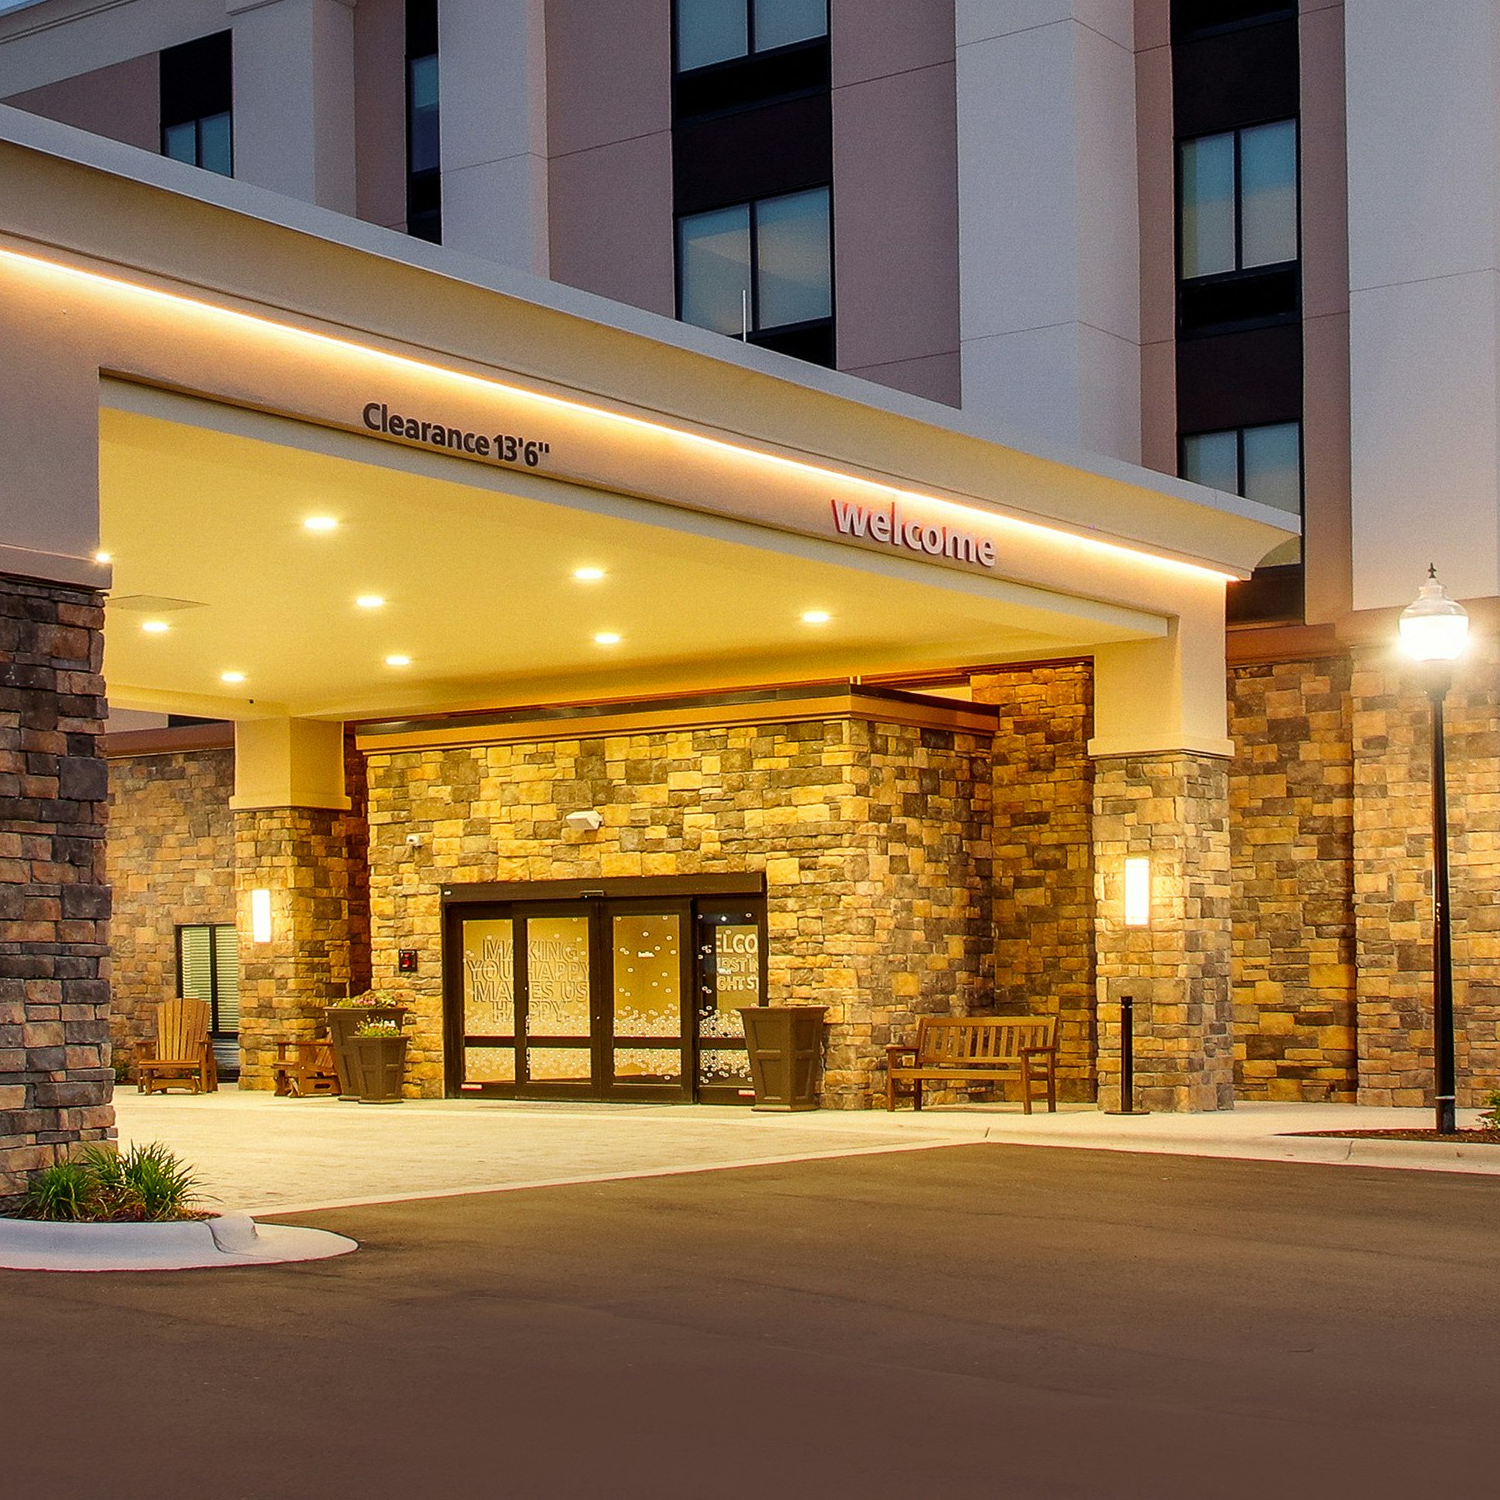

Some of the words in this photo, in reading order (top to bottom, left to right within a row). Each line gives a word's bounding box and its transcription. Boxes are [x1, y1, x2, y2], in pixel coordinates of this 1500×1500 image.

[362, 402, 490, 456] Clearance
[493, 434, 550, 467] 13'6"
[831, 499, 996, 567] welcome
[473, 981, 555, 1002] MAES
[560, 981, 588, 1002] US
